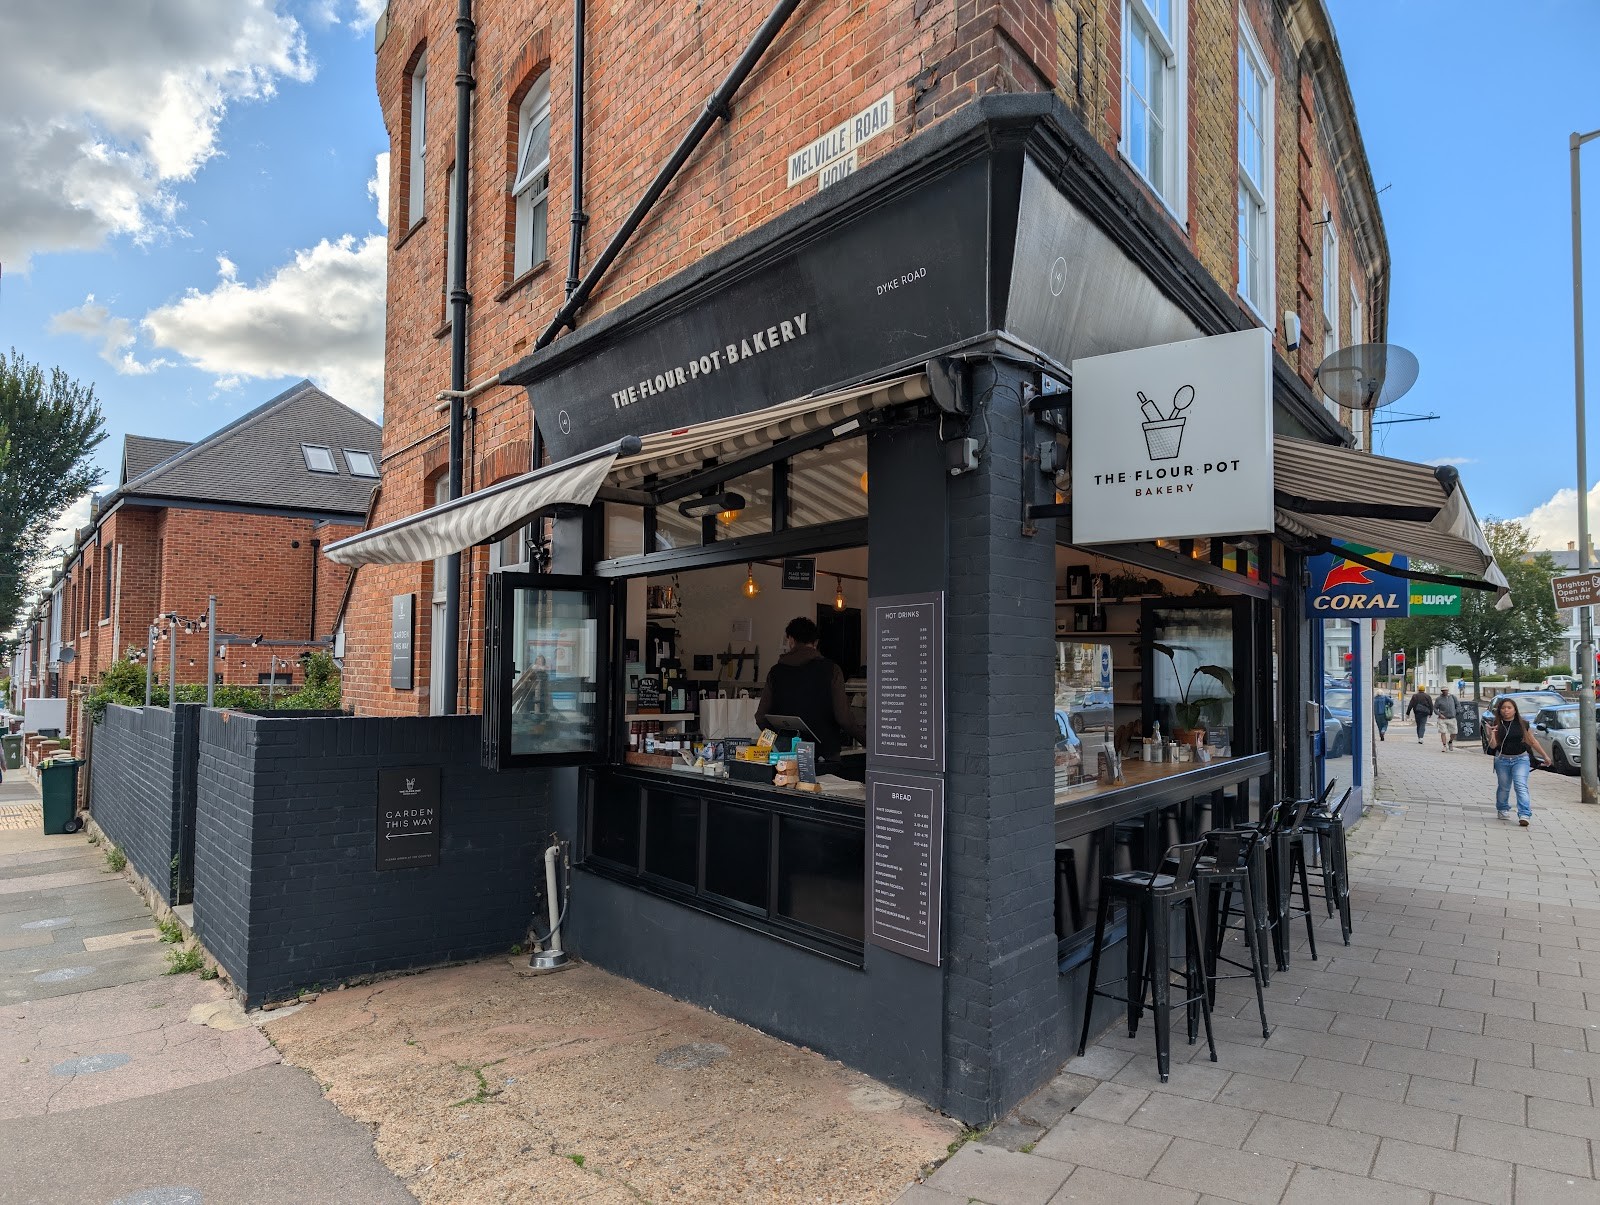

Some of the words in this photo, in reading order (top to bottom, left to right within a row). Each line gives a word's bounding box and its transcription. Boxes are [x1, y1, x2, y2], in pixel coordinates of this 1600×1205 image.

[791, 127, 846, 181] MELVILLE
[855, 100, 888, 144] ROAD
[823, 156, 854, 190] HOVE
[876, 278, 900, 296] DYKE
[901, 267, 927, 285] ROAD
[611, 386, 638, 409] THE
[639, 366, 688, 399] FLOUR
[688, 350, 723, 380] POT
[725, 312, 809, 365] BAKERY
[1094, 472, 1126, 486] THE
[1135, 465, 1194, 481] FLOUR
[1203, 459, 1240, 474] POT
[1135, 483, 1194, 497] BAKERY
[1556, 580, 1590, 590] Brighton
[1557, 589, 1578, 597] Open
[1580, 586, 1591, 594] Air
[1313, 594, 1400, 610] CORAL
[1560, 594, 1591, 603] Theatre
[885, 612, 897, 620] HOT
[897, 610, 920, 619] DRINKS
[11, 752, 17, 760] 4
[891, 792, 912, 802] BREAD
[385, 808, 434, 819] GARDEN
[385, 819, 409, 829] THIS
[412, 817, 434, 827] WAY
